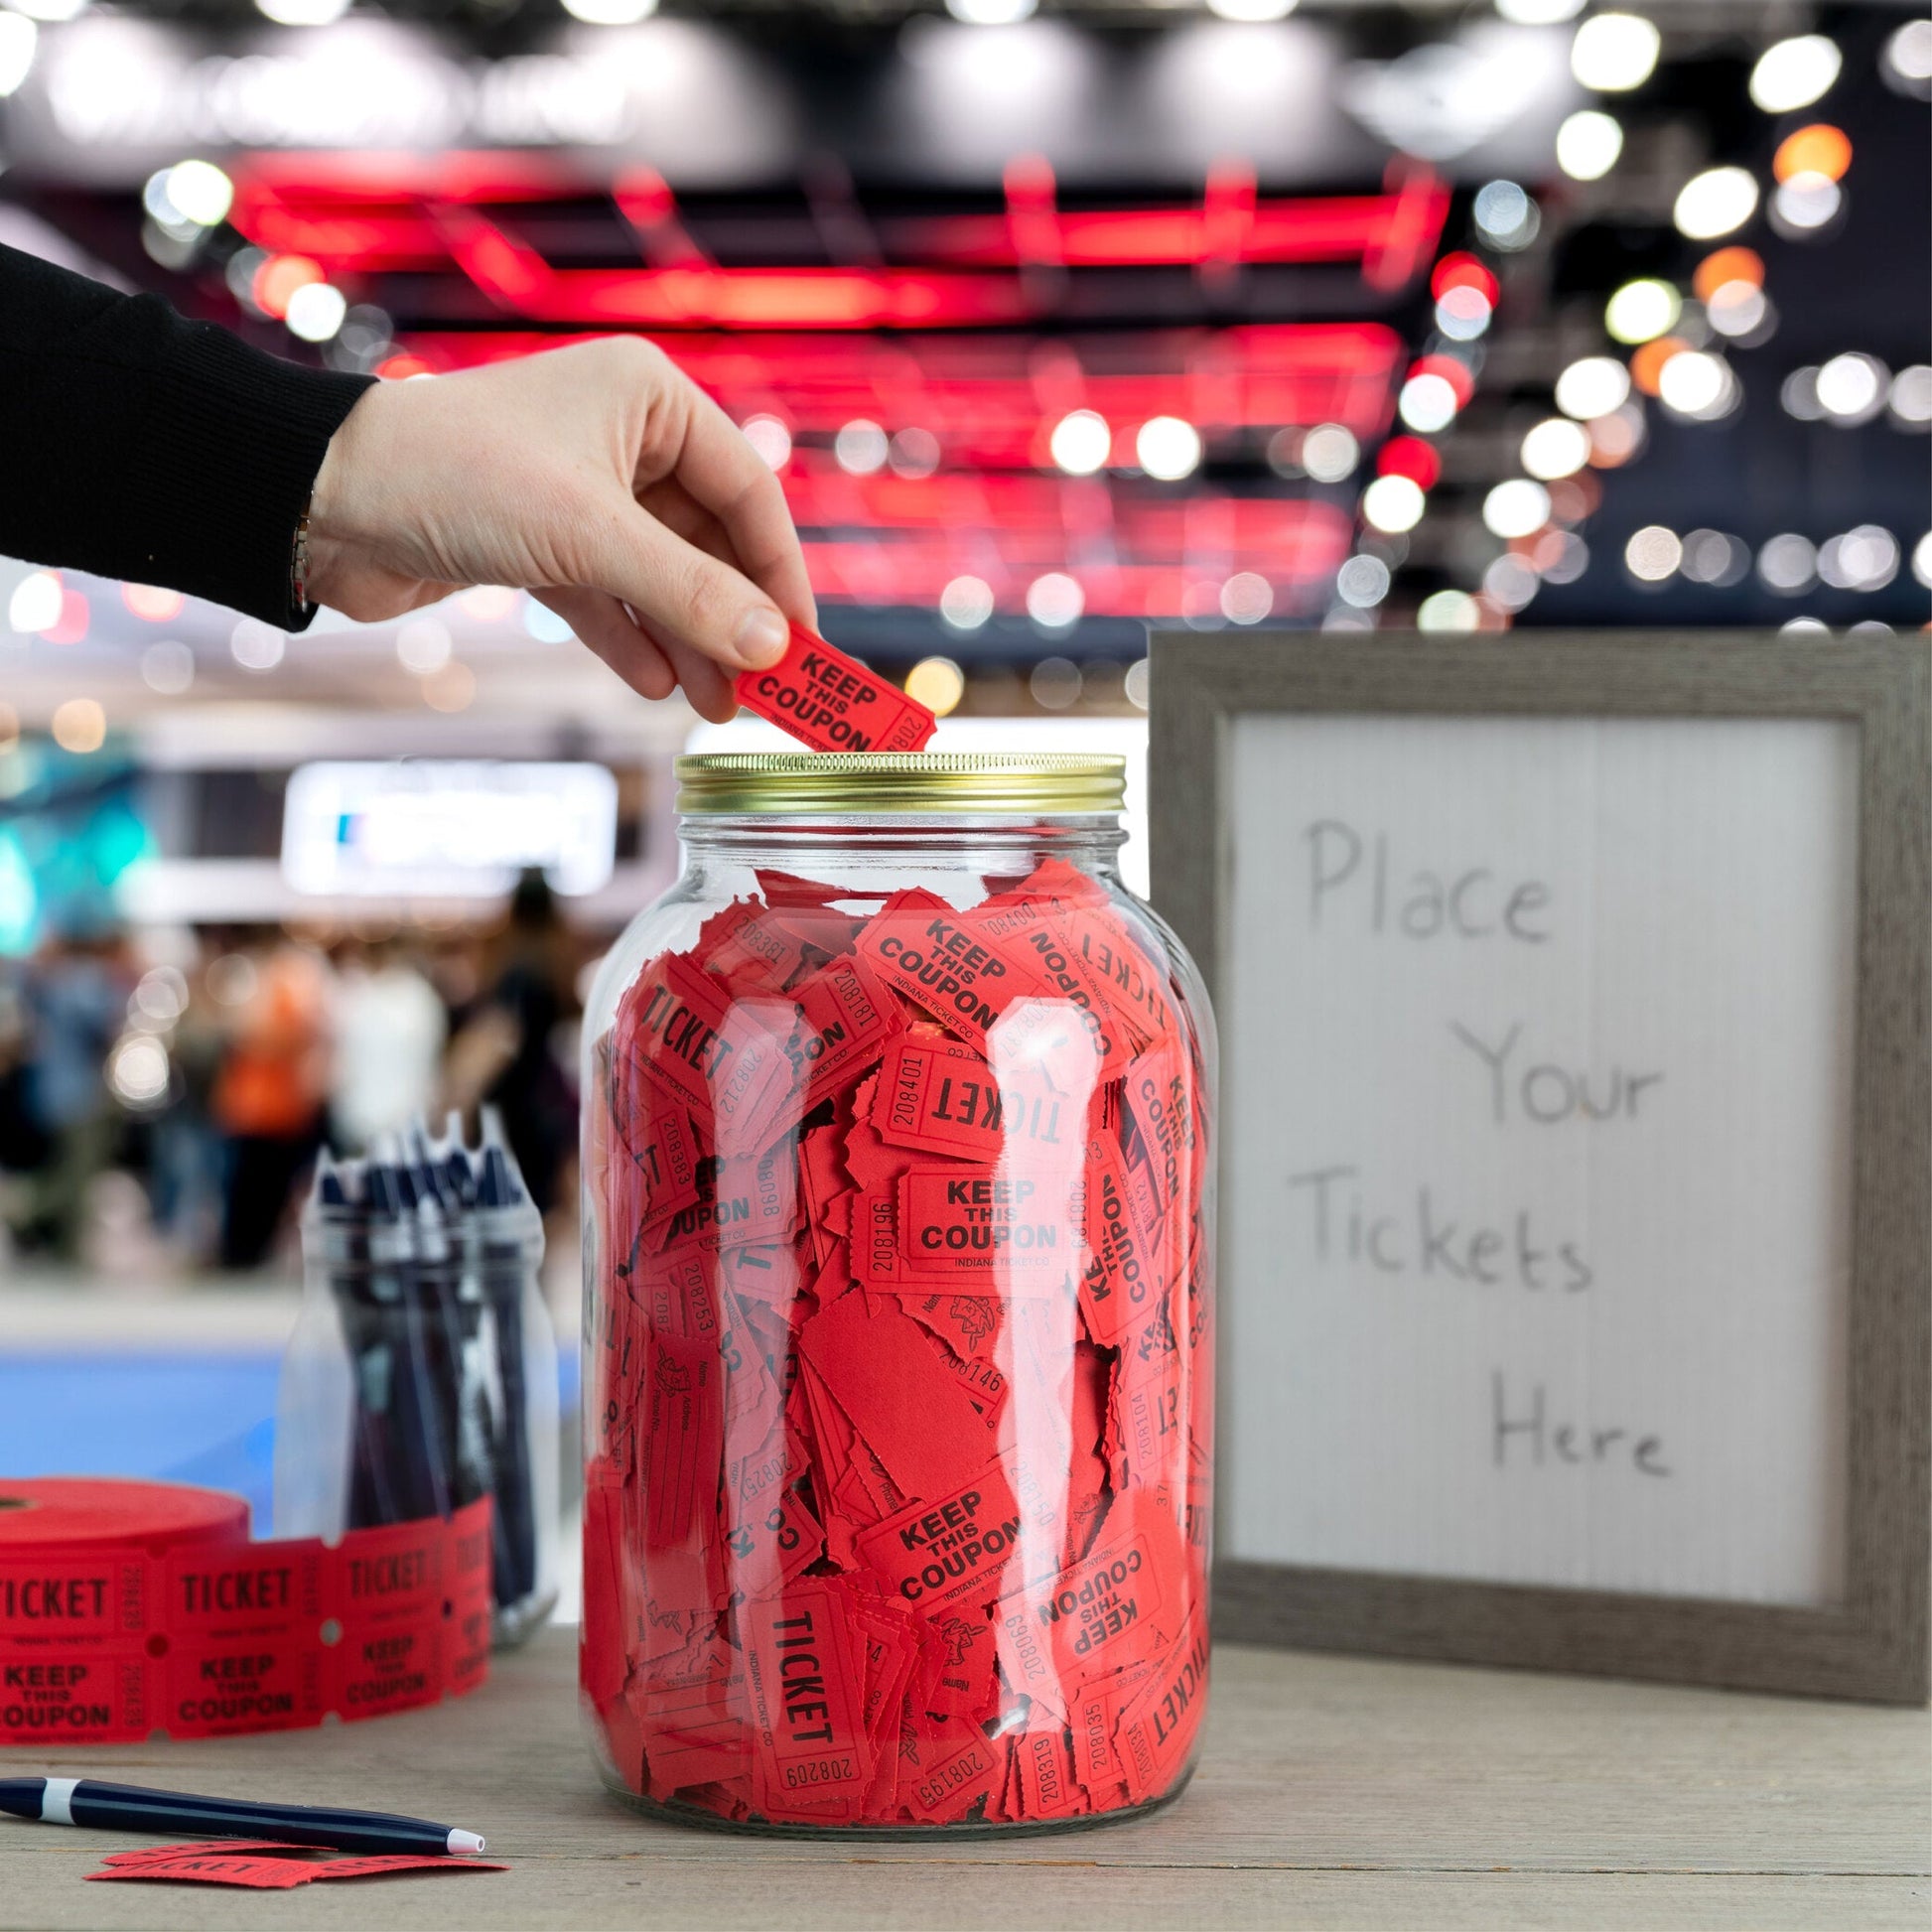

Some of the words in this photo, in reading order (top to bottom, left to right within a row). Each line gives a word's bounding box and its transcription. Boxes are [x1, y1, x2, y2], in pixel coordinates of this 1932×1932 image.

[800, 652, 877, 705] KEEP
[804, 680, 849, 714] THIS
[758, 676, 871, 752] COUPON
[1305, 819, 1553, 946] Place
[734, 916, 785, 964] 208381
[926, 918, 1006, 978] KEEP
[930, 945, 976, 984] THIS
[834, 969, 877, 1027] 208181
[880, 937, 999, 1031] COUPON
[893, 975, 928, 1004] INDIANA
[929, 1001, 959, 1028] TICKET
[1030, 932, 1112, 1055] COUPON
[641, 984, 735, 1081] TICKET
[720, 1048, 761, 1113] 208212
[894, 1057, 922, 1126] 208401
[1448, 1020, 1665, 1125] Your
[931, 1077, 1061, 1144] TICKET
[1142, 1079, 1179, 1199] COUPON
[1170, 1075, 1197, 1153] KEEP
[663, 1118, 691, 1185] 208383
[947, 1180, 1035, 1204] KEEP
[964, 1207, 1018, 1222] THIS
[873, 1203, 893, 1272] 208196
[921, 1225, 1056, 1249] COUPON
[1103, 1174, 1146, 1303] COUPON
[1290, 1166, 1593, 1294] Tickets
[955, 1258, 996, 1268] INDIANA
[1000, 1257, 1031, 1267] TICKET
[685, 1263, 715, 1331] 208253
[698, 1360, 708, 1388] Name
[681, 1396, 692, 1431] Address
[1492, 1367, 1674, 1478] Here
[881, 1482, 899, 1510] Phone
[899, 1491, 981, 1551] KEEP
[900, 1516, 1026, 1600] COUPON
[926, 1523, 979, 1557] THIS
[0, 1579, 107, 1618] ICKET
[182, 1569, 291, 1612] TICKET
[350, 1549, 425, 1597] TICKET
[944, 1577, 982, 1601] INDIANA
[982, 1557, 1013, 1578] TICKET
[1038, 1550, 1142, 1626] COUPON
[1074, 1597, 1138, 1655] KEEP
[1080, 1591, 1121, 1623] THIS
[5, 1665, 88, 1687] KEEP
[202, 1654, 275, 1679] KEEP
[1005, 1613, 1045, 1681] 208069
[22, 1690, 71, 1703] THIS
[347, 1672, 426, 1705] COUPON
[749, 1650, 762, 1693] INDIANA
[758, 1693, 770, 1731] TICKET
[772, 1610, 834, 1743] TICKET
[942, 1676, 970, 1692] Name
[1154, 1638, 1207, 1746] TICKET
[3, 1705, 110, 1728] OUPON
[180, 1693, 293, 1722] COUPON
[1086, 1704, 1107, 1769] 208035
[786, 1759, 853, 1786] 208209
[919, 1752, 983, 1805] 208195
[1034, 1738, 1058, 1803] 208319
[125, 1861, 260, 1874] TICKET
